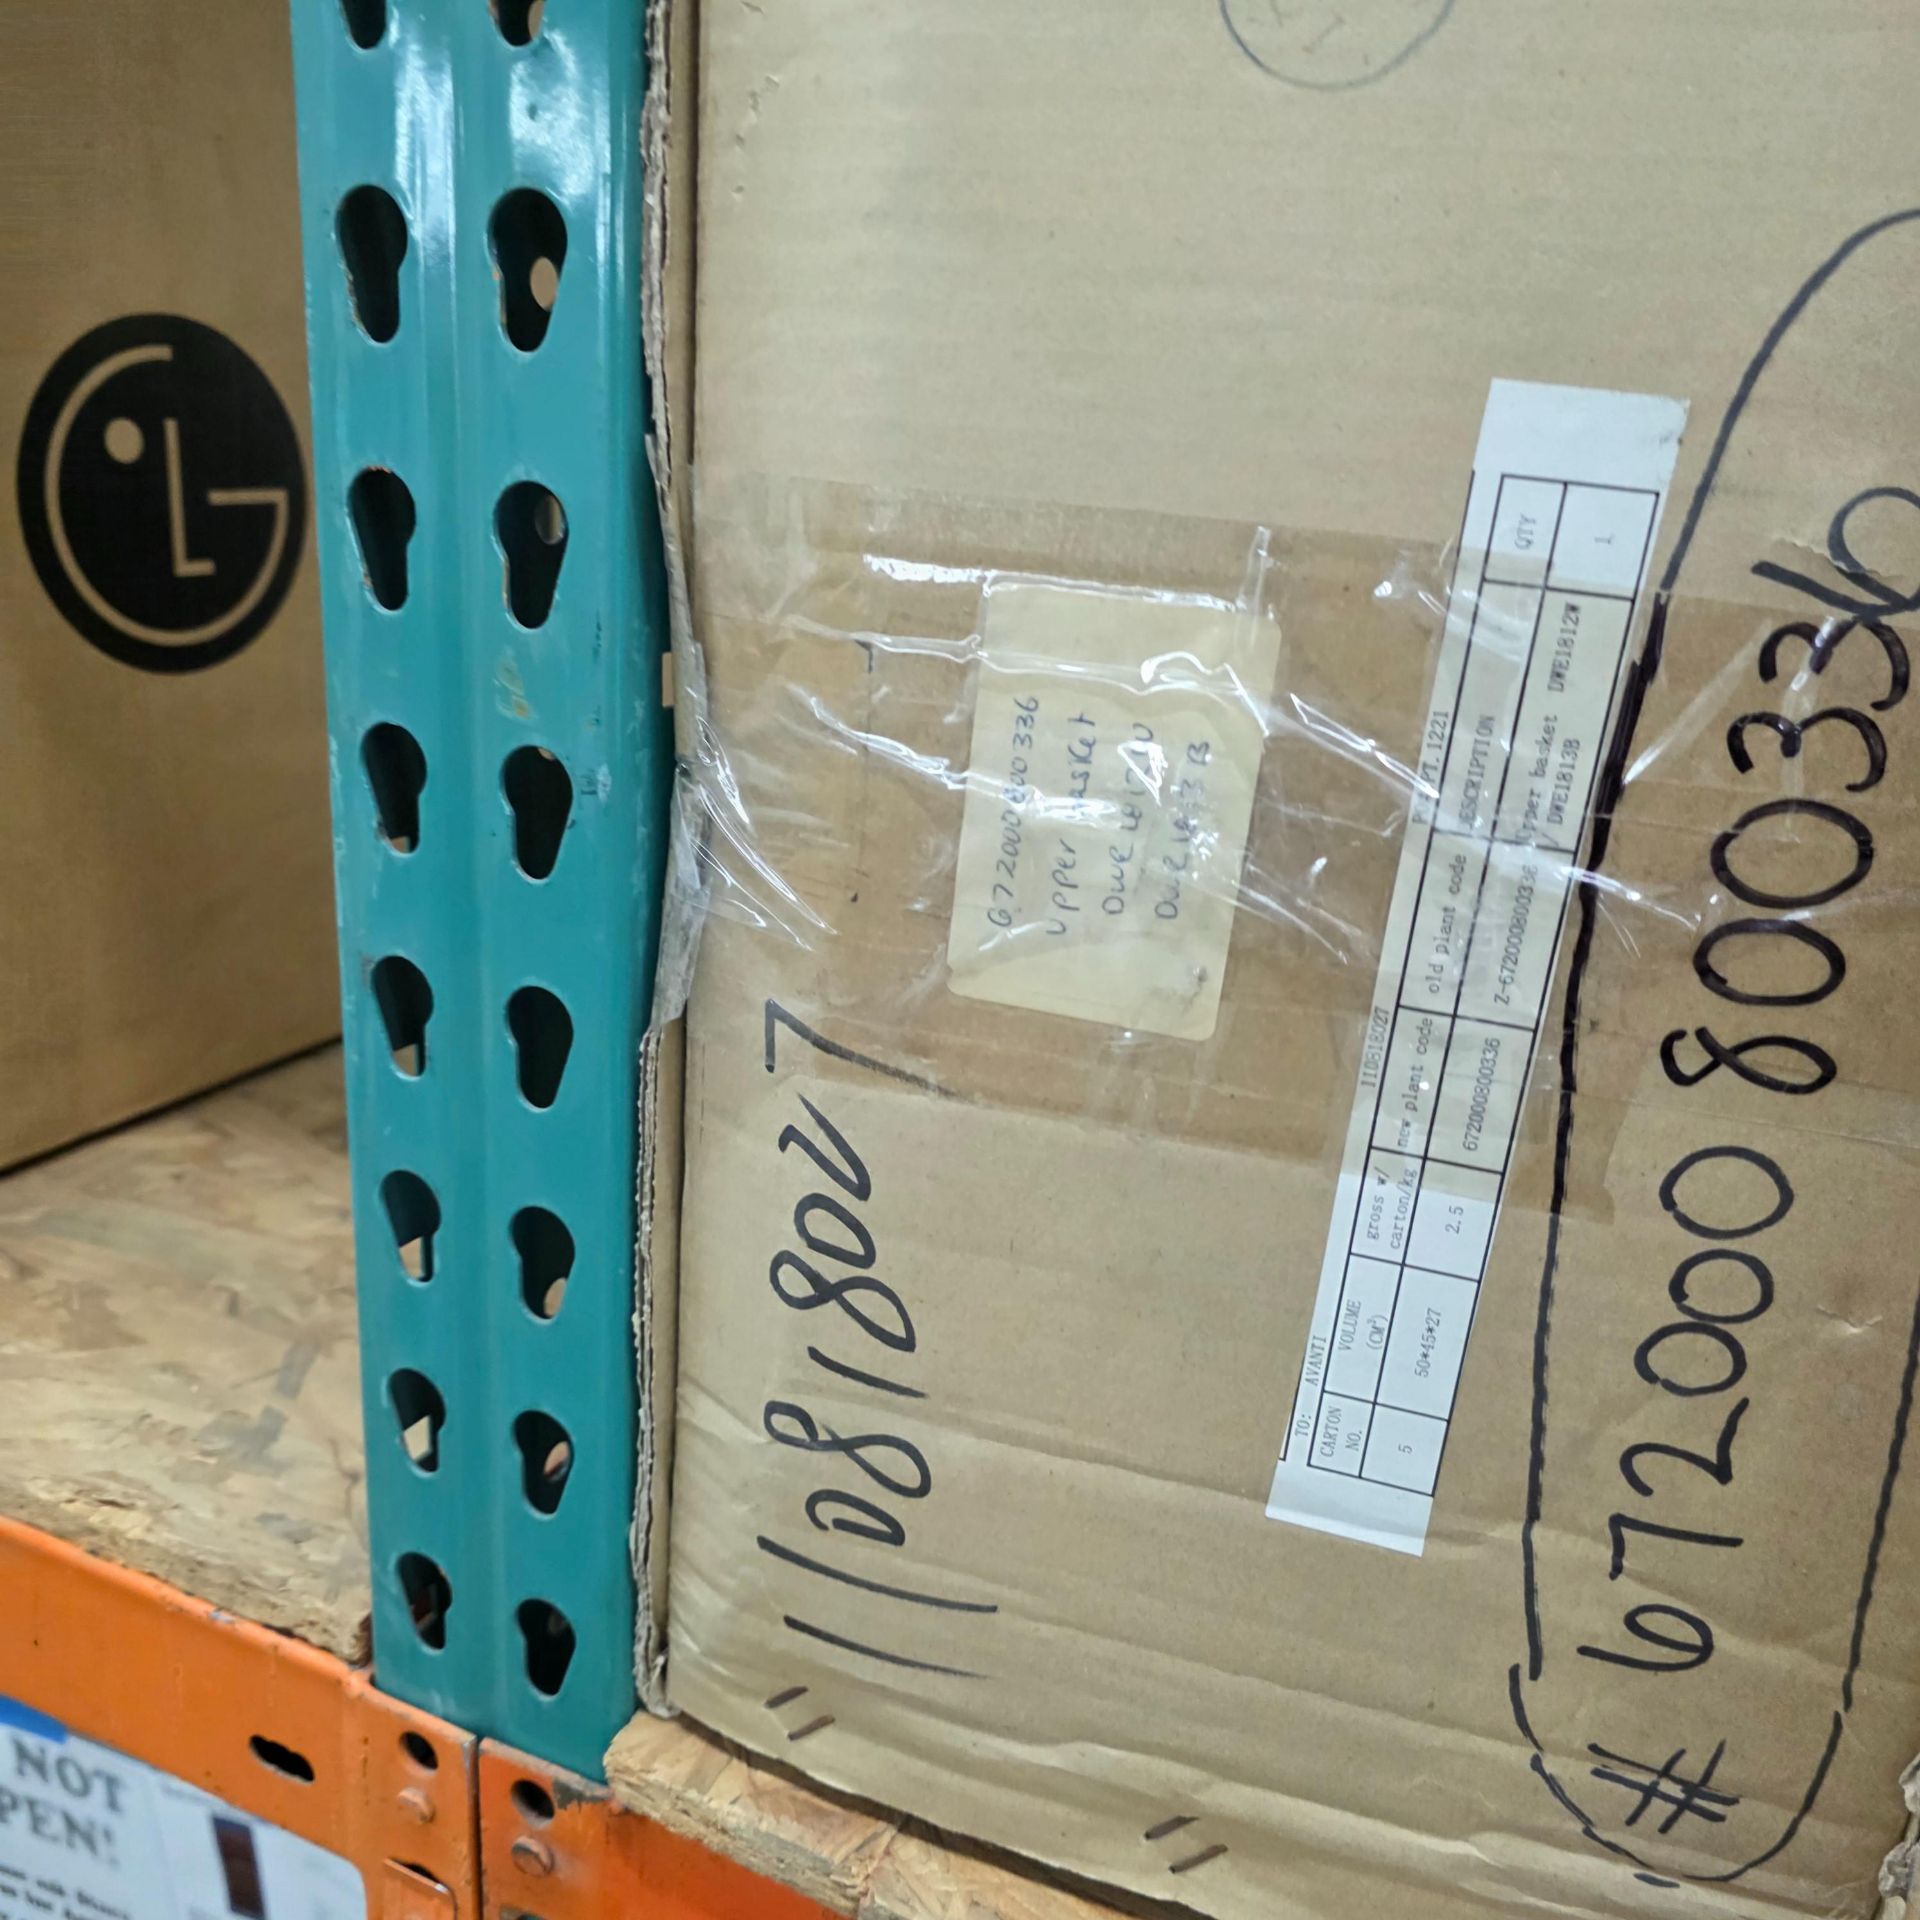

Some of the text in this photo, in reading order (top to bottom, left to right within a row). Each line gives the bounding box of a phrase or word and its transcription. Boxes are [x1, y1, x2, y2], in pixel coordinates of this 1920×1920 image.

[45, 343, 290, 648] LG
[1514, 514, 1538, 550] QTY
[1528, 714, 1558, 779] basket
[1547, 601, 1582, 693] DWE1812W
[1546, 737, 1581, 825] DWE1813B
[1425, 854, 1467, 995] old plant code
[1397, 1017, 1433, 1149] new plant code
[1462, 1037, 1501, 1152] 672000800336
[1294, 1413, 1312, 1437] TO:
[1305, 1335, 1327, 1387] AVANTI
[1360, 1006, 1390, 1089] 110818027
[1366, 1194, 1385, 1241] gross
[1390, 1168, 1418, 1250] carton/kg
[1444, 1205, 1464, 1235] 2.5
[1337, 1298, 1362, 1352] VOLUME
[1319, 1405, 1343, 1458] CARTON
[1345, 1429, 1363, 1452] NO.
[1398, 1443, 1413, 1454] 5
[11, 1734, 124, 1816] NOT
